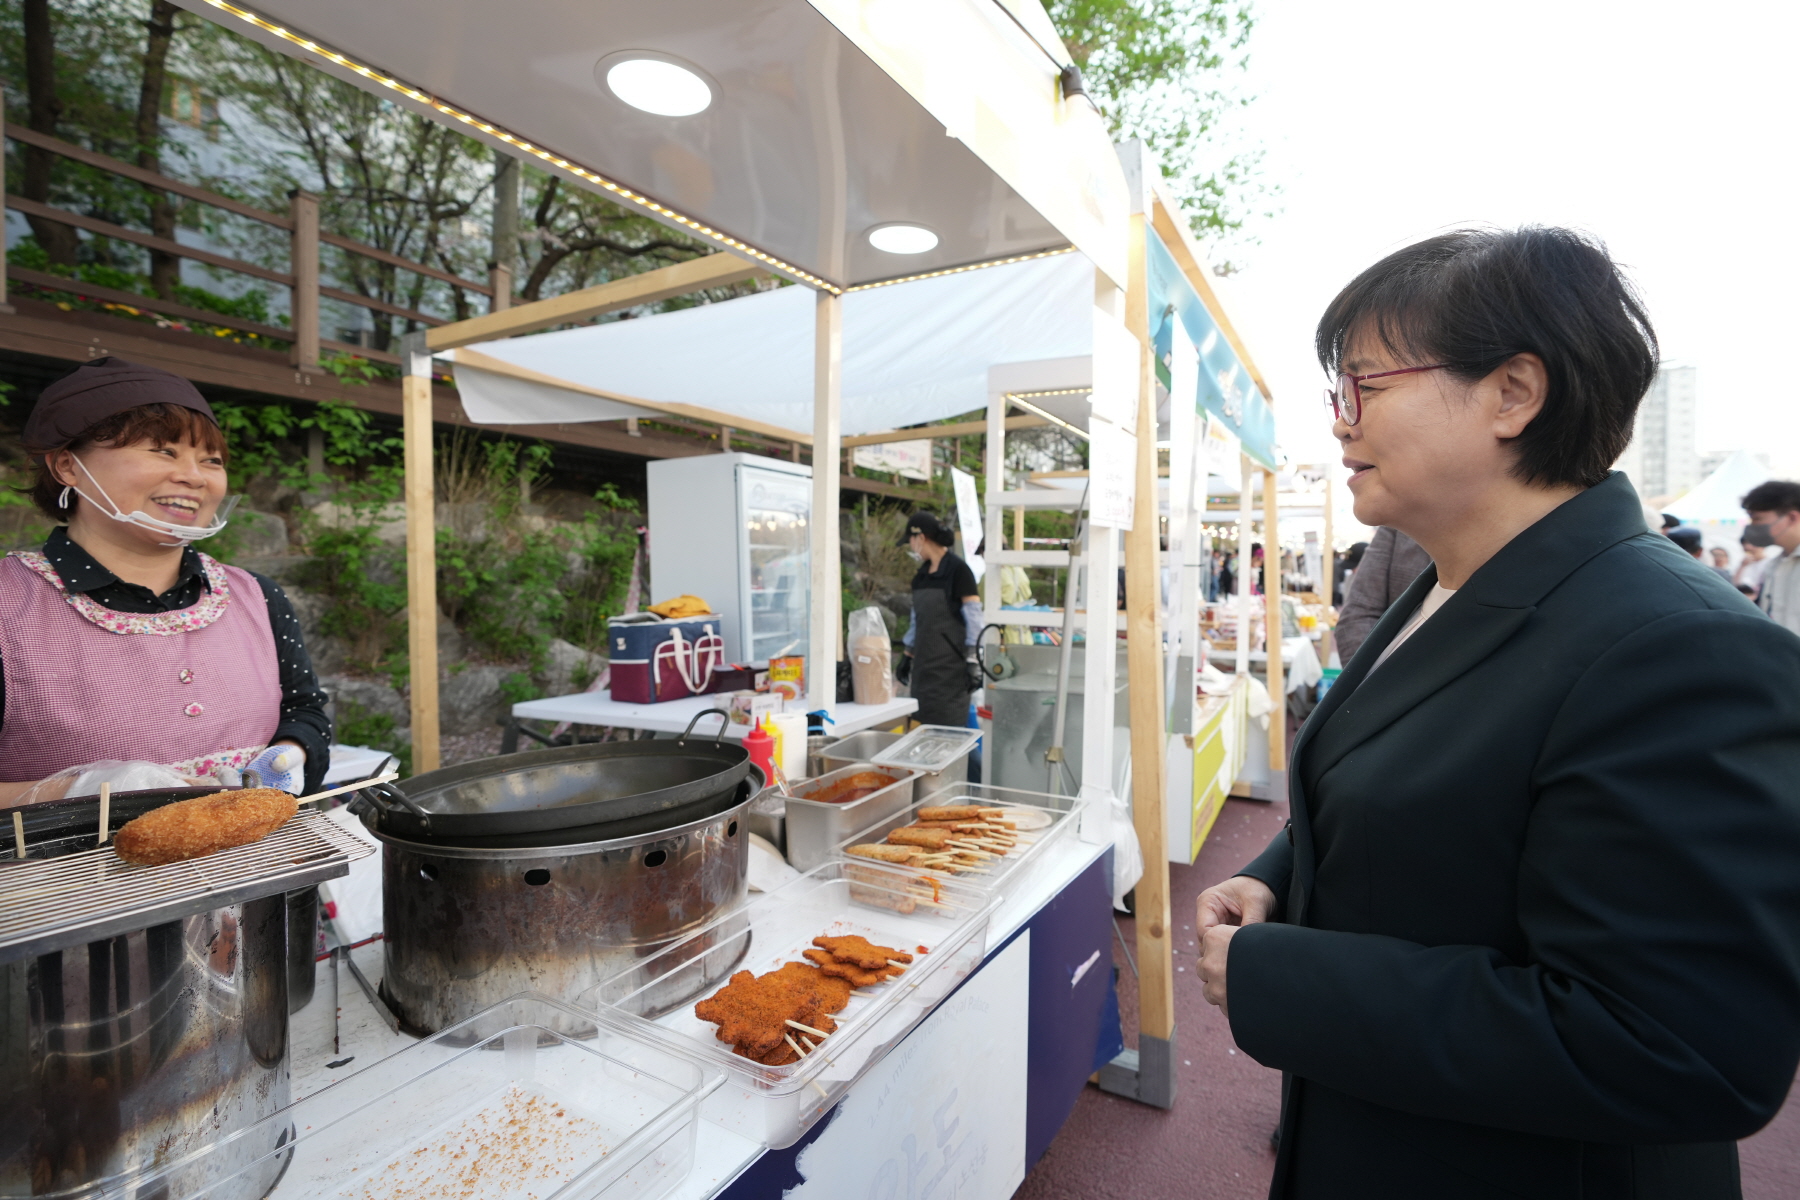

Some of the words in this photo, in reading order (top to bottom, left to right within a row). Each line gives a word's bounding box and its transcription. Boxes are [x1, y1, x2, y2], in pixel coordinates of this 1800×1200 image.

[867, 1082, 891, 1130] 2.44
[892, 1040, 918, 1083] miles
[919, 1015, 943, 1043] from
[967, 995, 990, 1014] Palace
